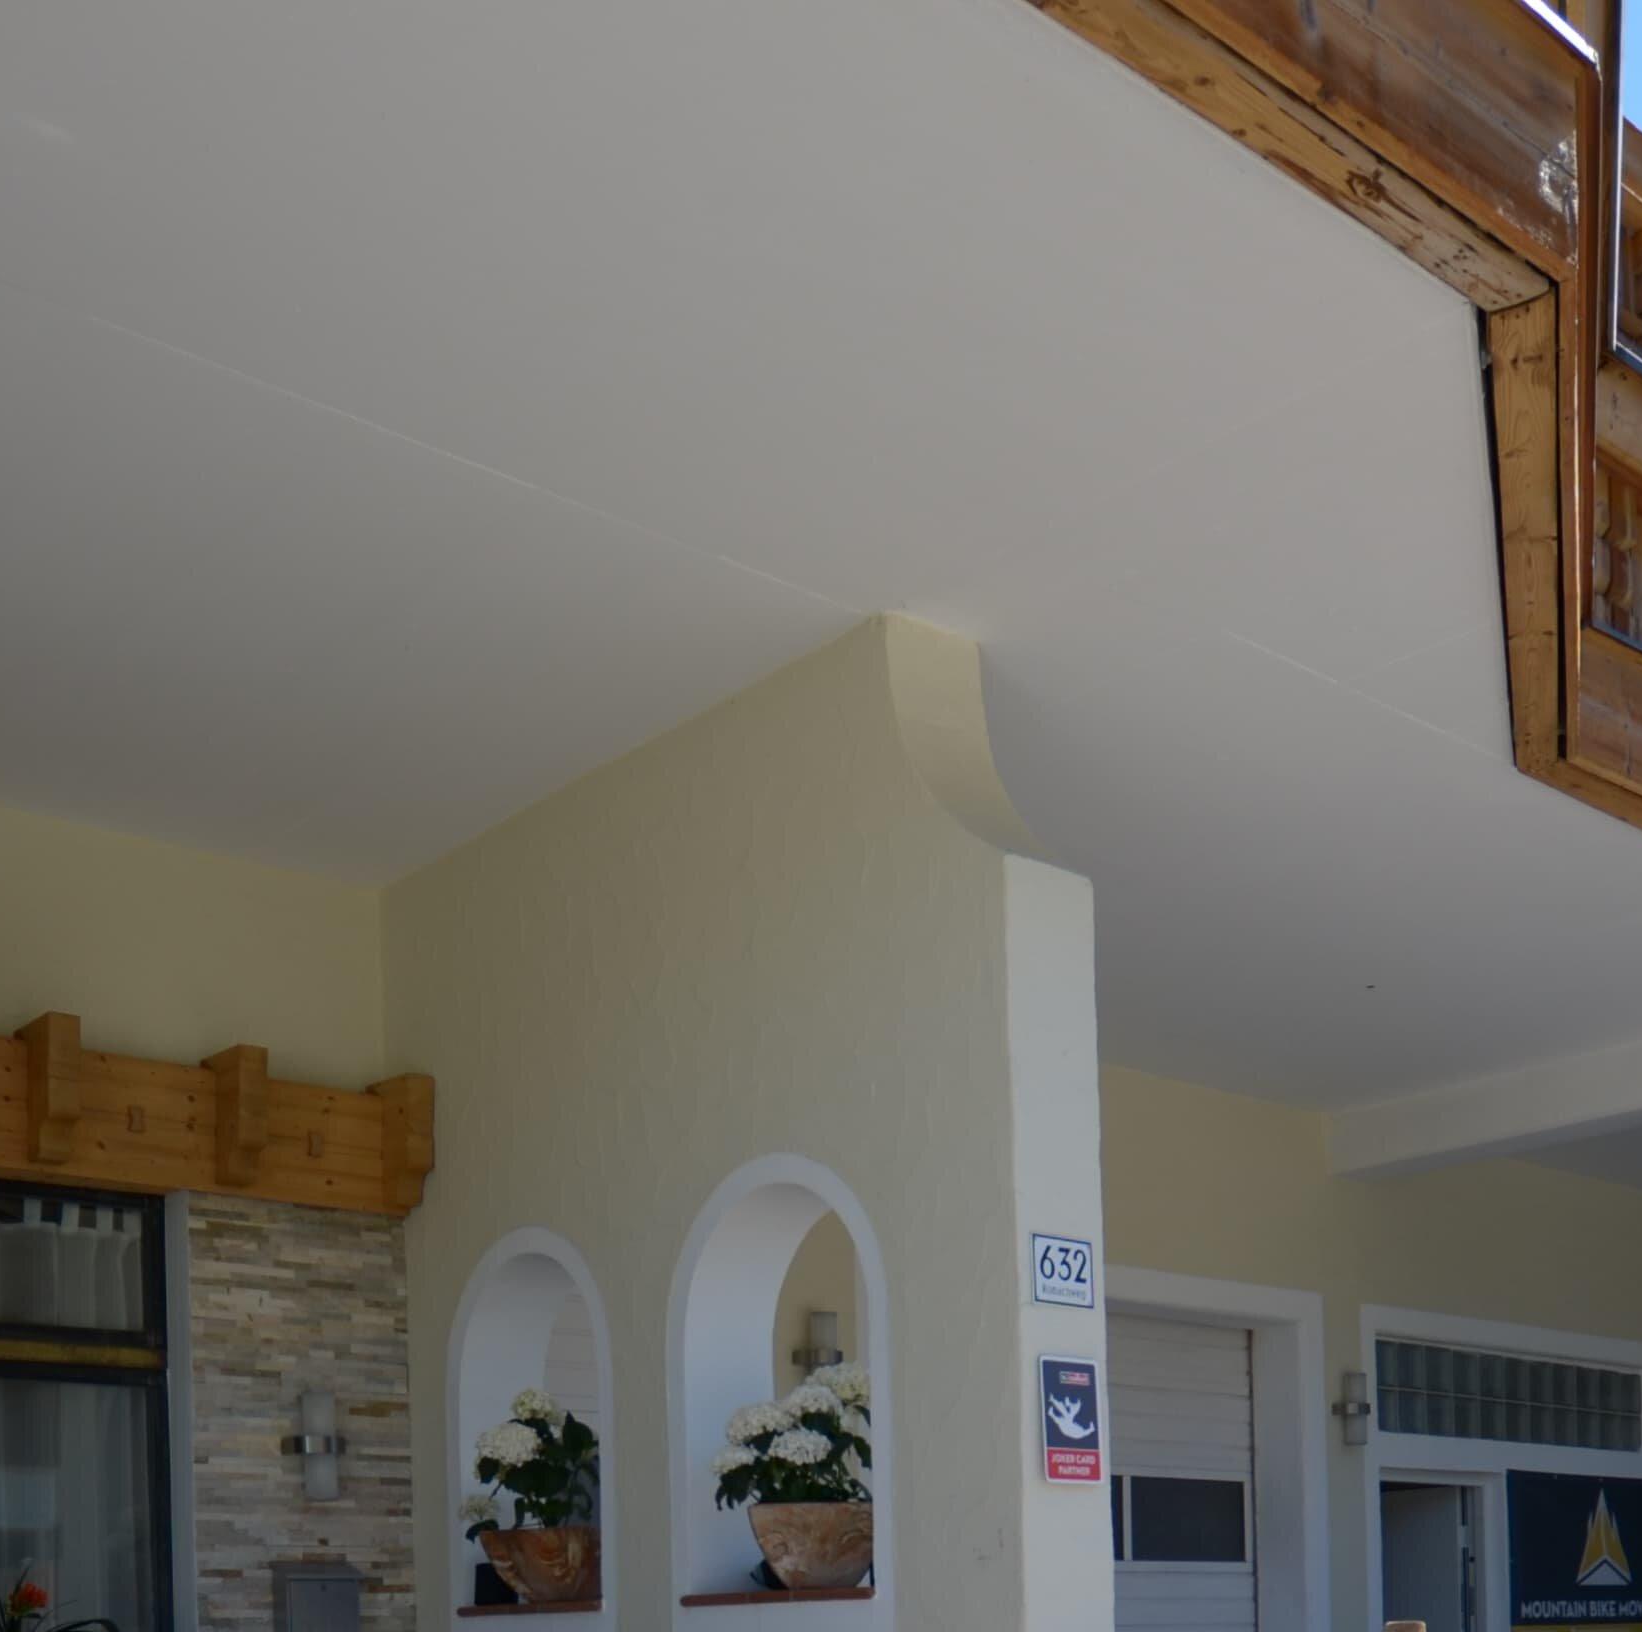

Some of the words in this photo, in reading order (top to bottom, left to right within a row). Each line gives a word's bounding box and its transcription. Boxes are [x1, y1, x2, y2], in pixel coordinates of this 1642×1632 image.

[1040, 1245, 1087, 1283] 632
[1077, 1455, 1095, 1465] CARD
[1059, 1465, 1090, 1475] PARTNER
[1521, 1601, 1586, 1618] MOUNTAIN
[1590, 1601, 1616, 1617] BIKE
